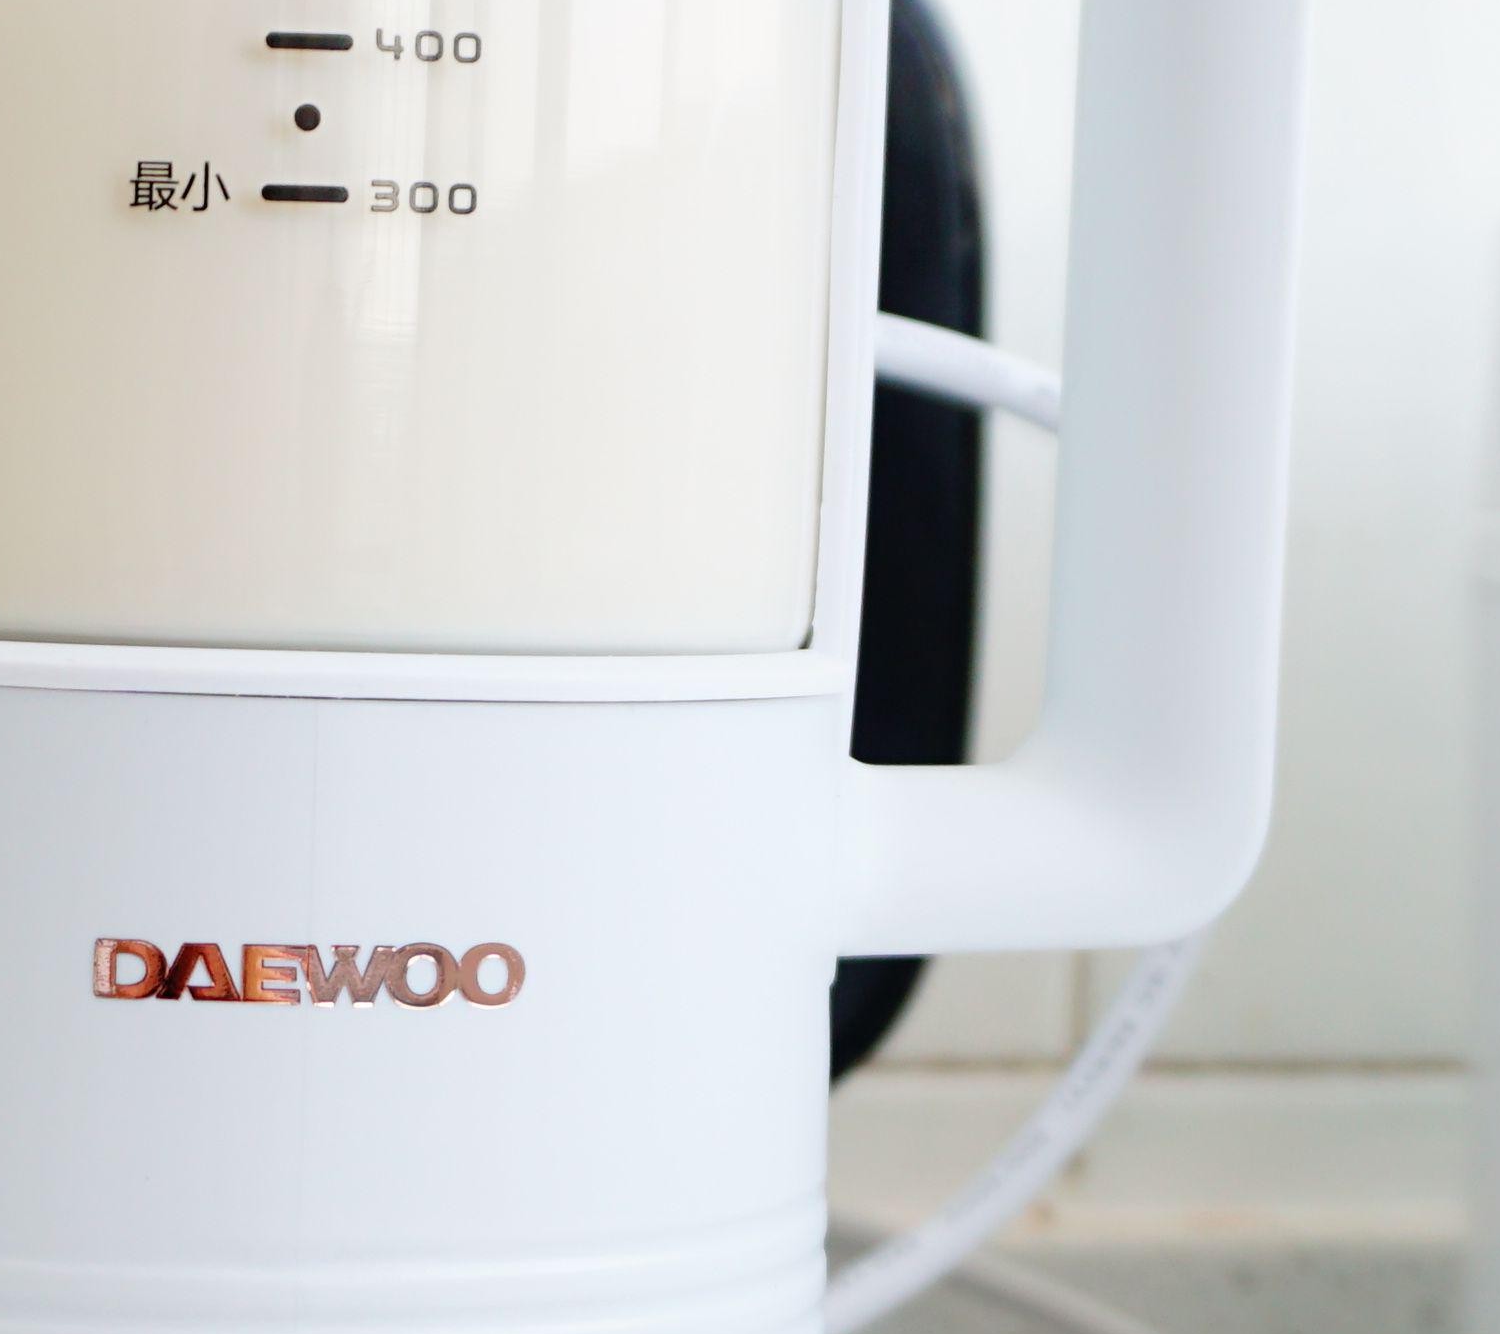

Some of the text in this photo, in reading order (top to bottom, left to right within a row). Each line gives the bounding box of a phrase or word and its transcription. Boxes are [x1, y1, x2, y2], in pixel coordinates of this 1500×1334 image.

[374, 27, 483, 65] 400
[128, 160, 478, 216] 最小 300
[92, 937, 526, 1010] DAEWOO
